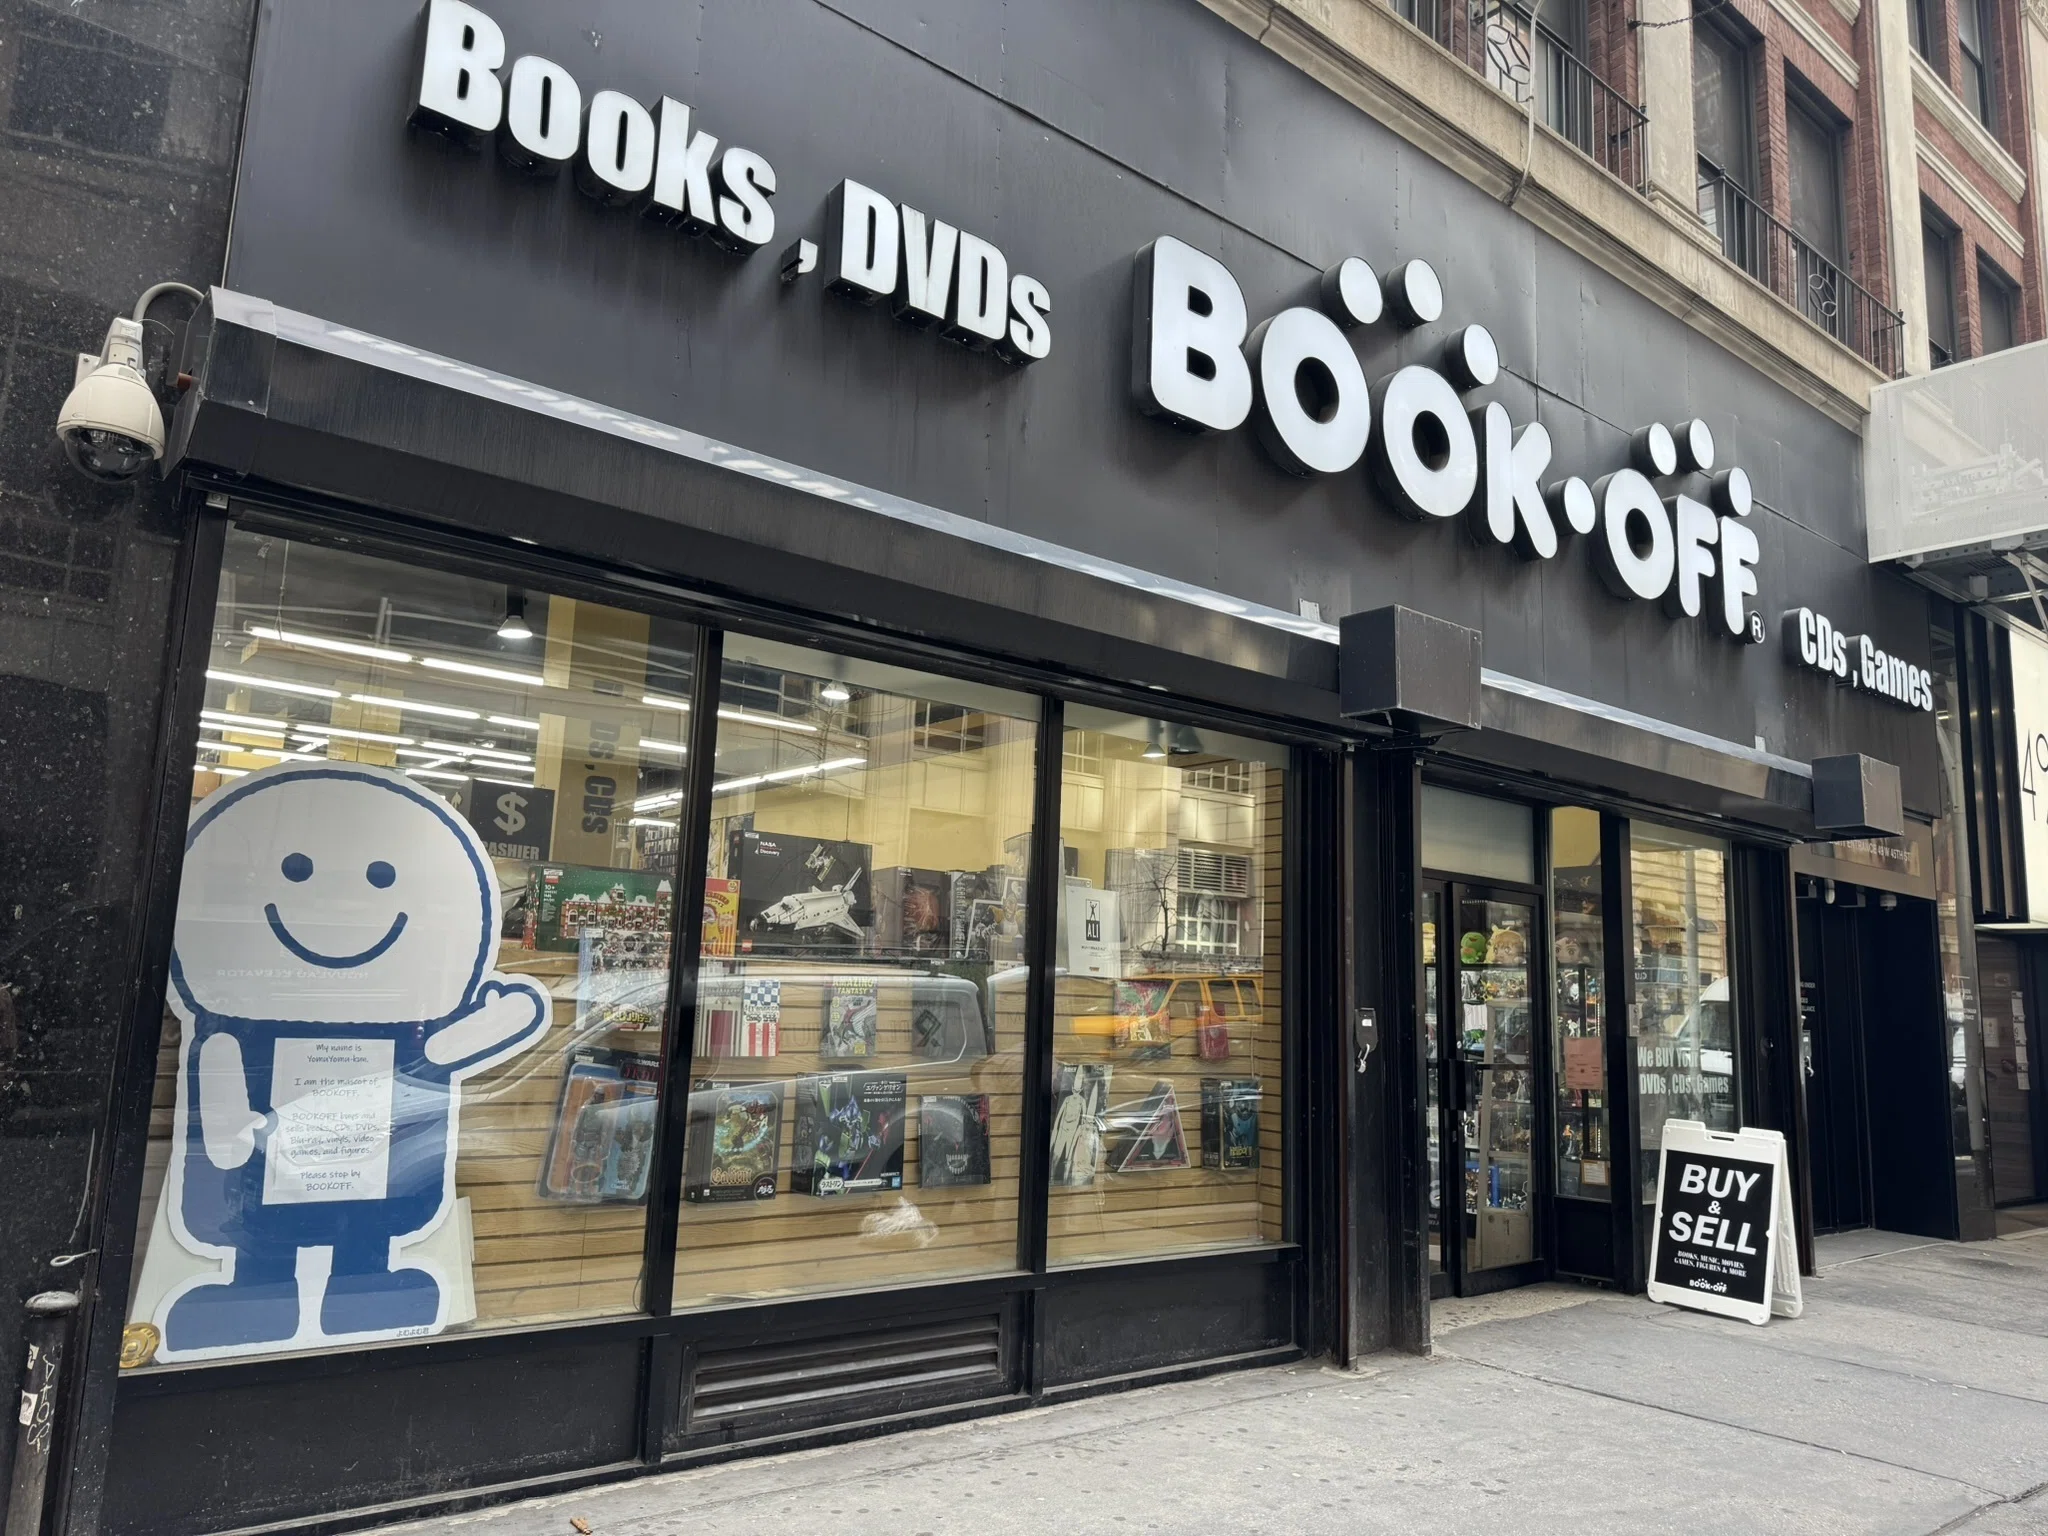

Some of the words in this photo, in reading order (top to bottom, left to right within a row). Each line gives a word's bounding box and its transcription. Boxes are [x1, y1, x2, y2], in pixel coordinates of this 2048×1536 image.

[840, 178, 1052, 360] DVDs
[1860, 634, 1933, 712] Games
[1087, 923, 1099, 938] ALI
[316, 1044, 329, 1052] My
[355, 1044, 362, 1052] is
[1637, 1047, 1654, 1067] We
[1655, 1047, 1674, 1067] BUY
[1676, 1047, 1699, 1067] Your
[320, 1077, 335, 1086] the
[338, 1078, 366, 1086] mascot
[369, 1077, 379, 1086] of
[1697, 1073, 1729, 1094] Games
[292, 1112, 337, 1121] BOOKOFF
[353, 1135, 375, 1143] video
[322, 1147, 338, 1155] and
[300, 1171, 327, 1180] Please
[329, 1171, 349, 1180] stop
[351, 1170, 361, 1179] by
[1679, 1163, 1760, 1202] BUY
[306, 1182, 354, 1191] BOOKOFF.
[1708, 1201, 1721, 1214] &
[1668, 1211, 1757, 1255] SELL
[1674, 1257, 1695, 1267] GAMES,
[1696, 1261, 1721, 1272] FIGURES
[1729, 1268, 1747, 1277] MORE
[1677, 1250, 1699, 1260] BOOKS,
[1721, 1258, 1744, 1269] MOVIES
